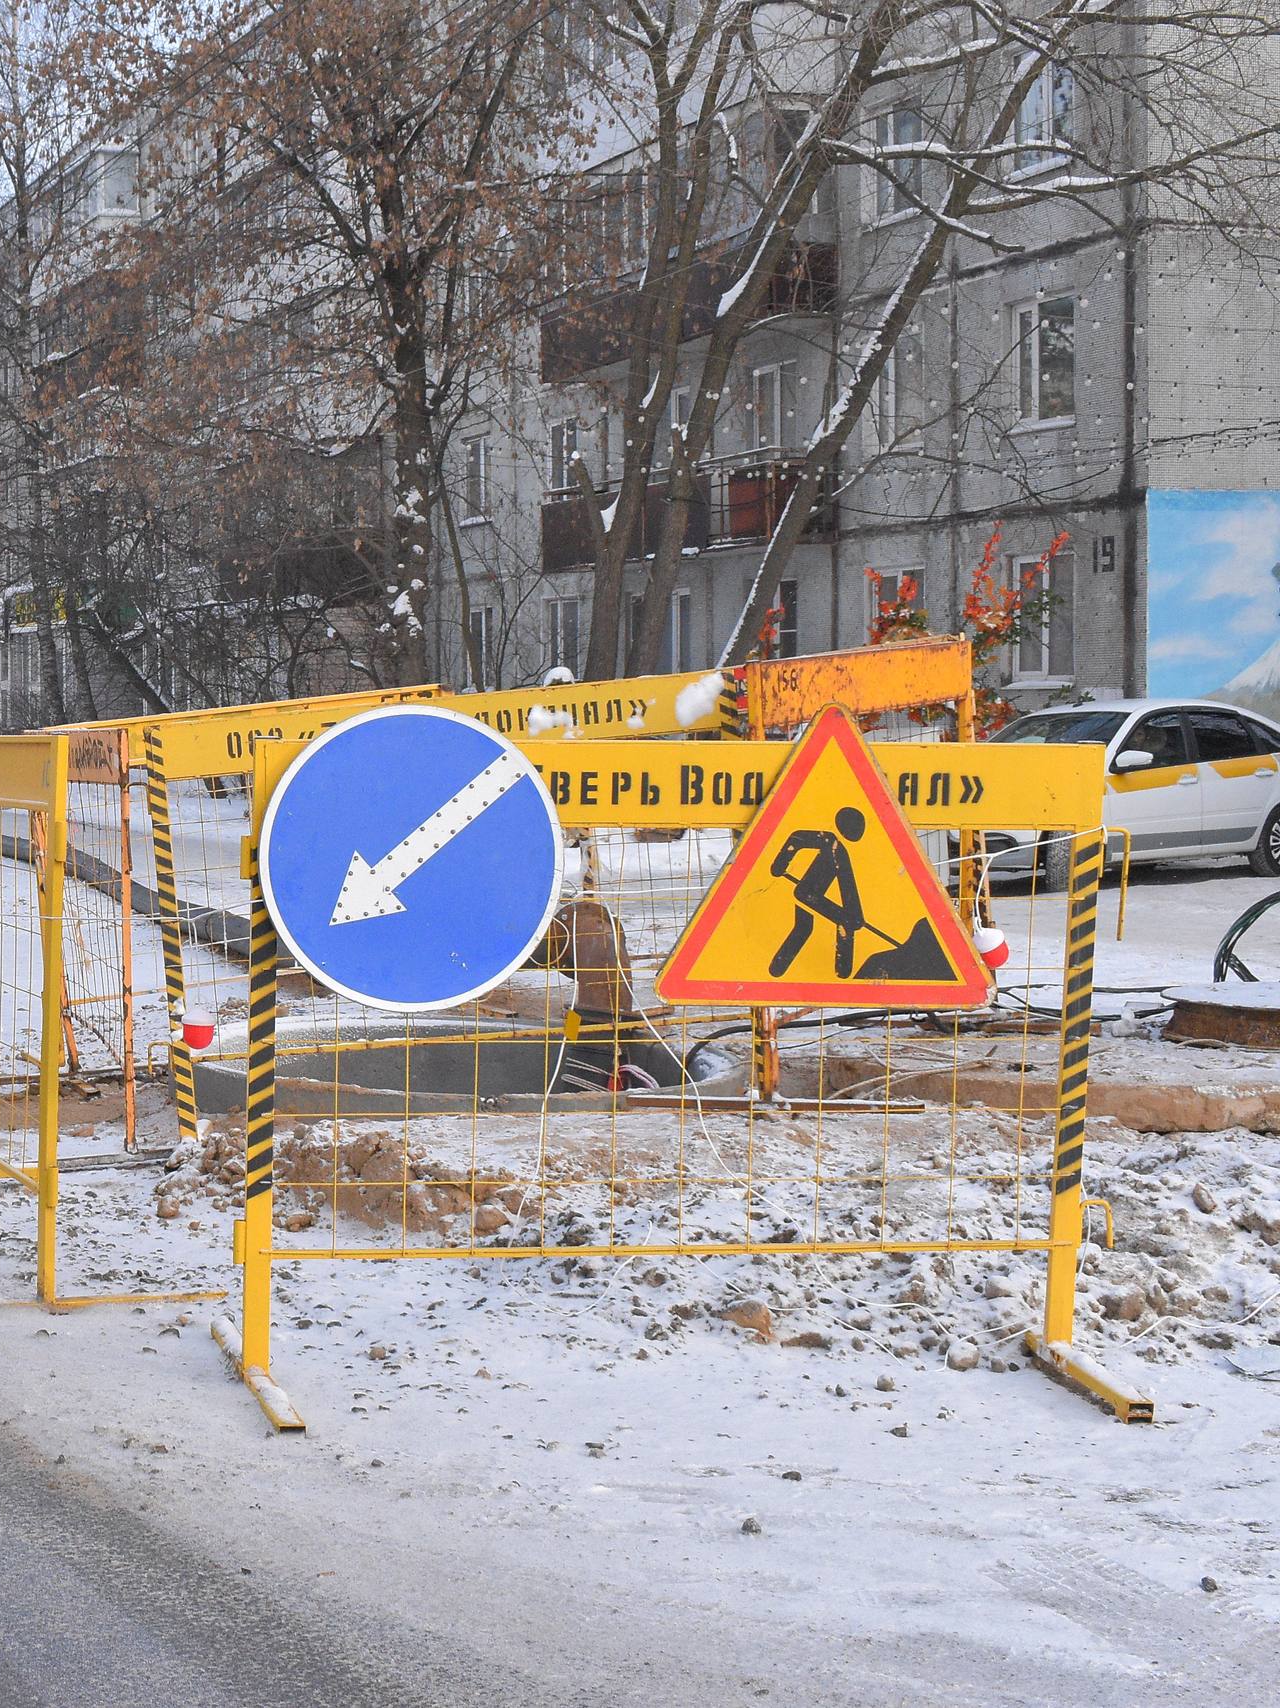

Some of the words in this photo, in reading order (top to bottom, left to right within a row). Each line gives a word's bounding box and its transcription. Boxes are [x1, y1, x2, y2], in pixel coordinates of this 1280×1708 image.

[1093, 536, 1115, 574] 19
[533, 765, 661, 806] ВЕРЬ
[680, 765, 984, 806] ВОДАЛ»
